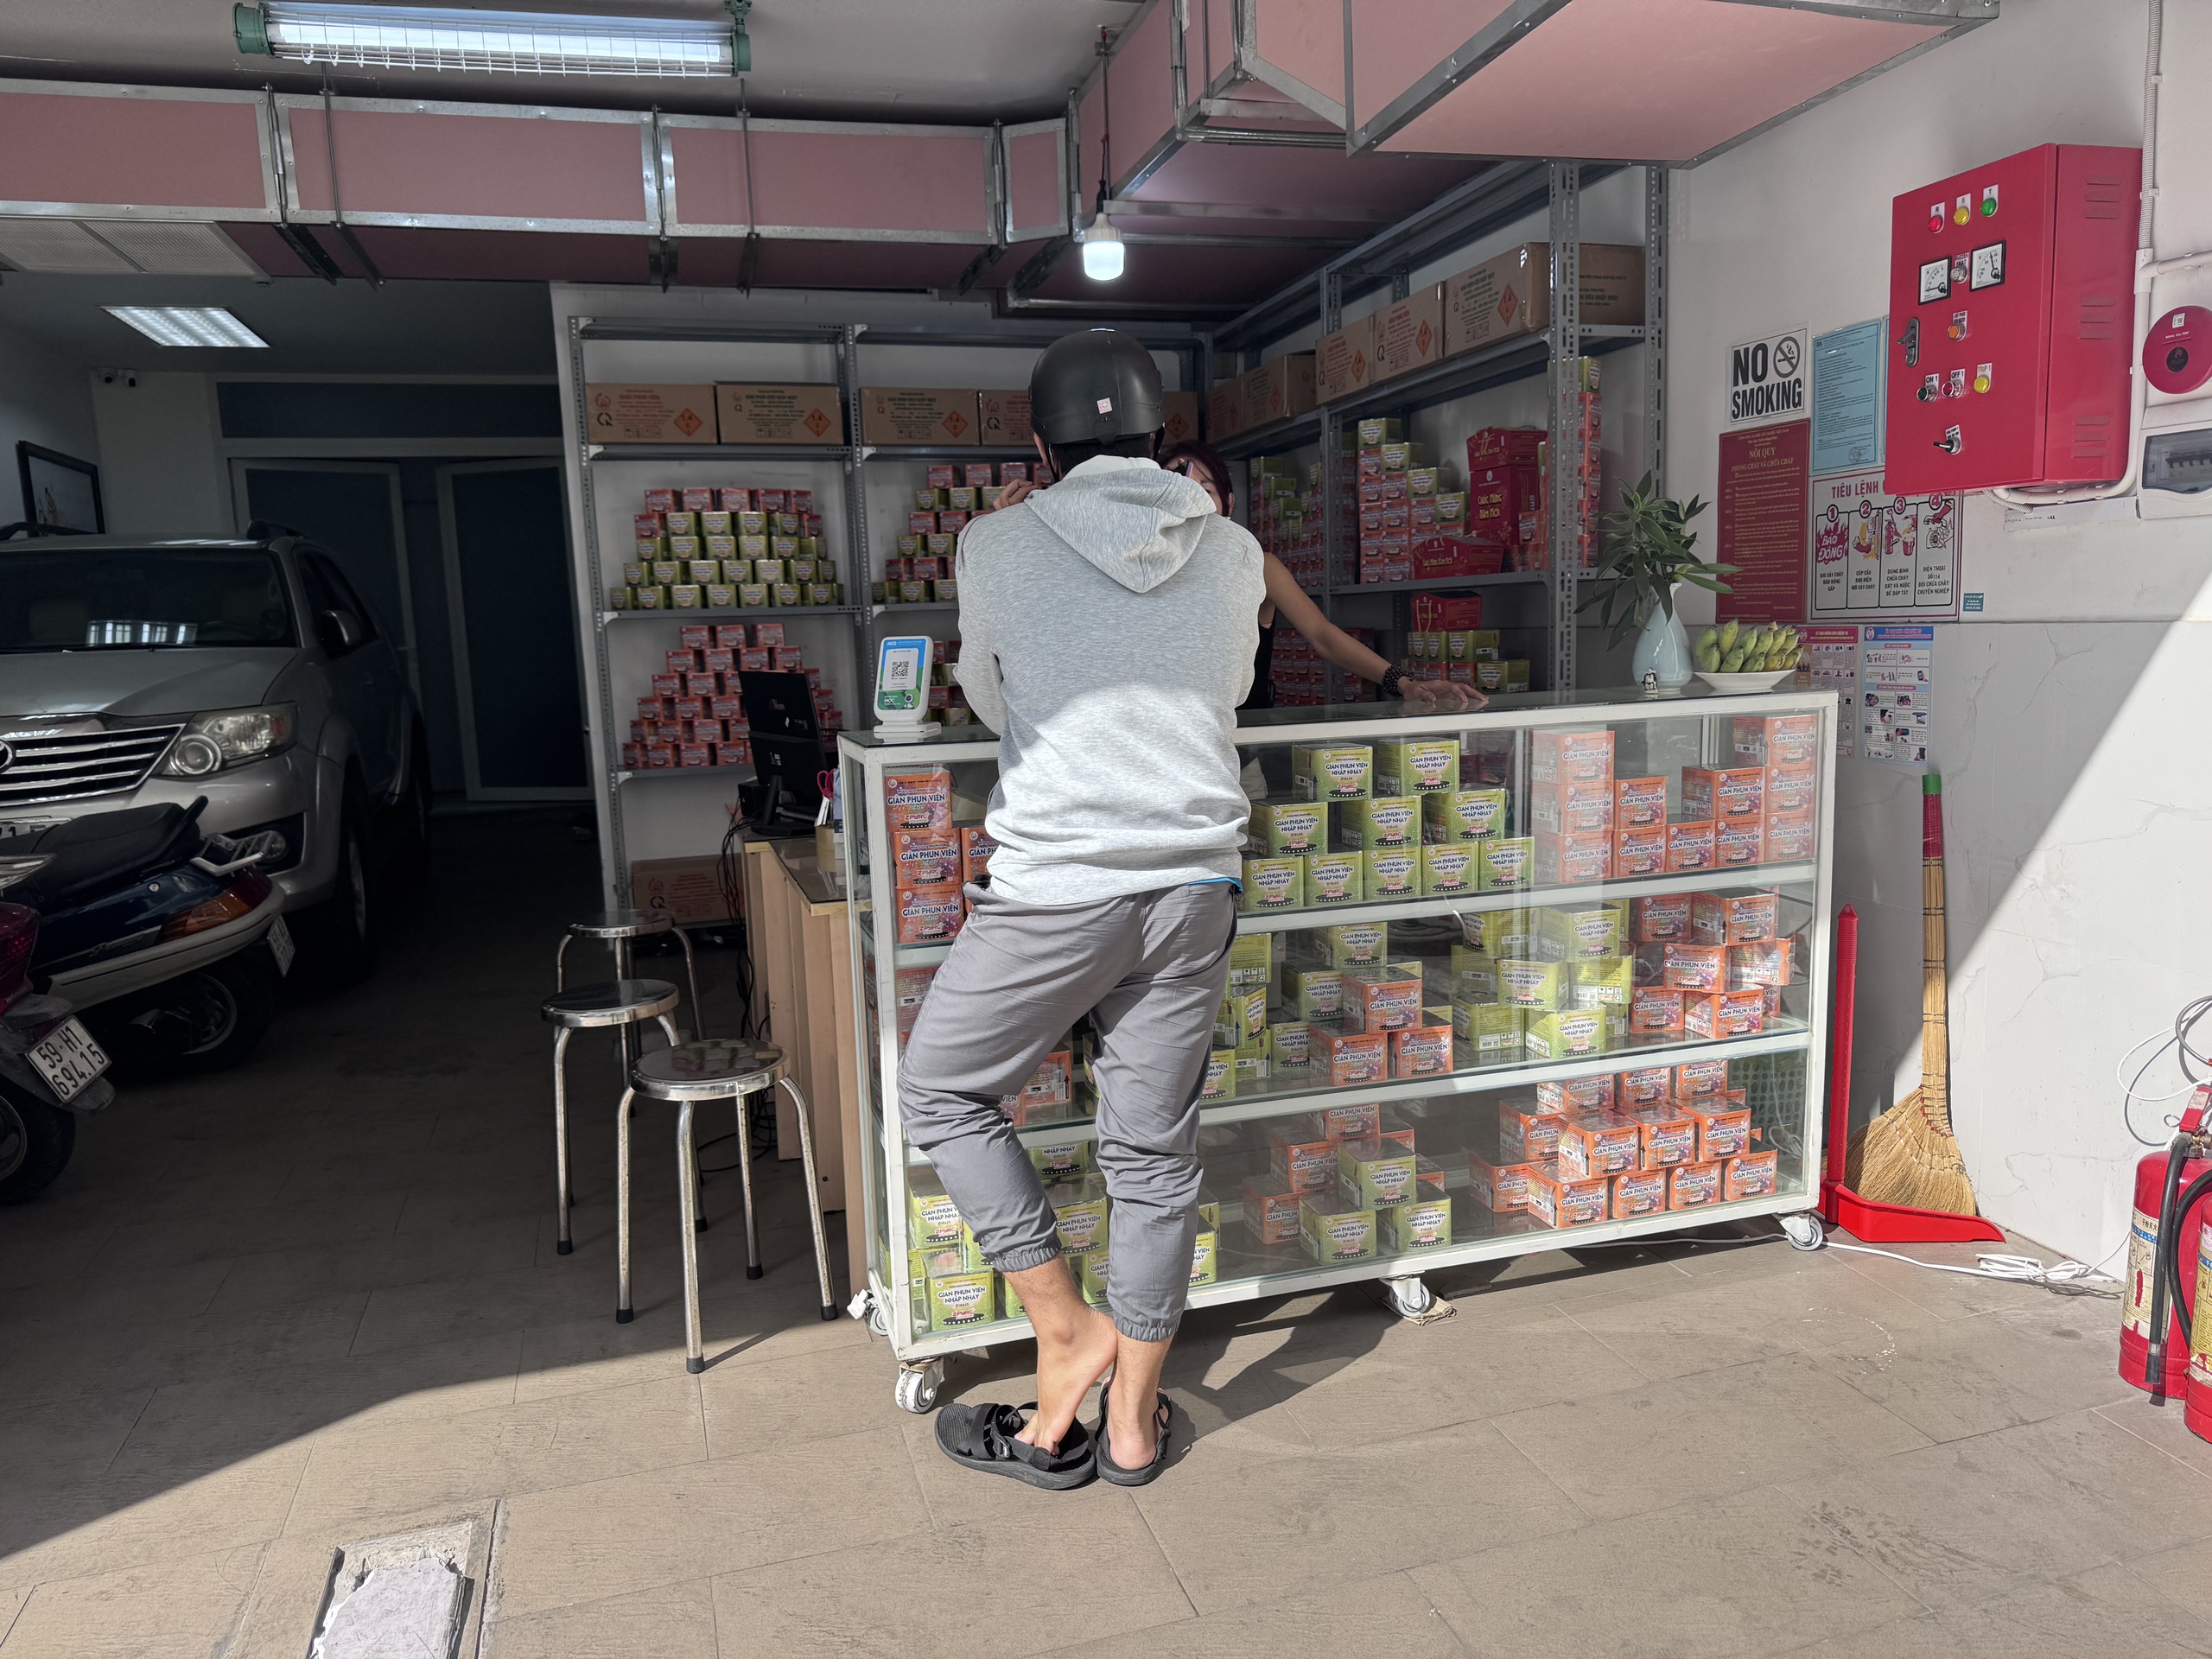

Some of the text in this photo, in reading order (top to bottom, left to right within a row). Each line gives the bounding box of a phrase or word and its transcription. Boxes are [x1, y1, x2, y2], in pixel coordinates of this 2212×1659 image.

[1733, 342, 1768, 387] NO
[1732, 378, 1802, 419] SMOKING
[1762, 447, 1776, 458] QUY
[1832, 483, 1852, 499] TIÊU
[1855, 480, 1878, 498] LỆNH
[1931, 493, 1940, 505] 4
[1862, 503, 1870, 515] 2
[1897, 499, 1904, 512] 3
[1830, 507, 1835, 519] 1
[888, 795, 906, 804] GIÀN
[930, 793, 945, 802] VIÊN
[901, 852, 918, 861] GIÀN
[941, 849, 957, 857] VIÊN
[969, 848, 985, 856] GIÀN
[903, 907, 919, 916] GIÀN
[943, 904, 959, 912] VIÊN
[51, 1042, 105, 1096] 694.15
